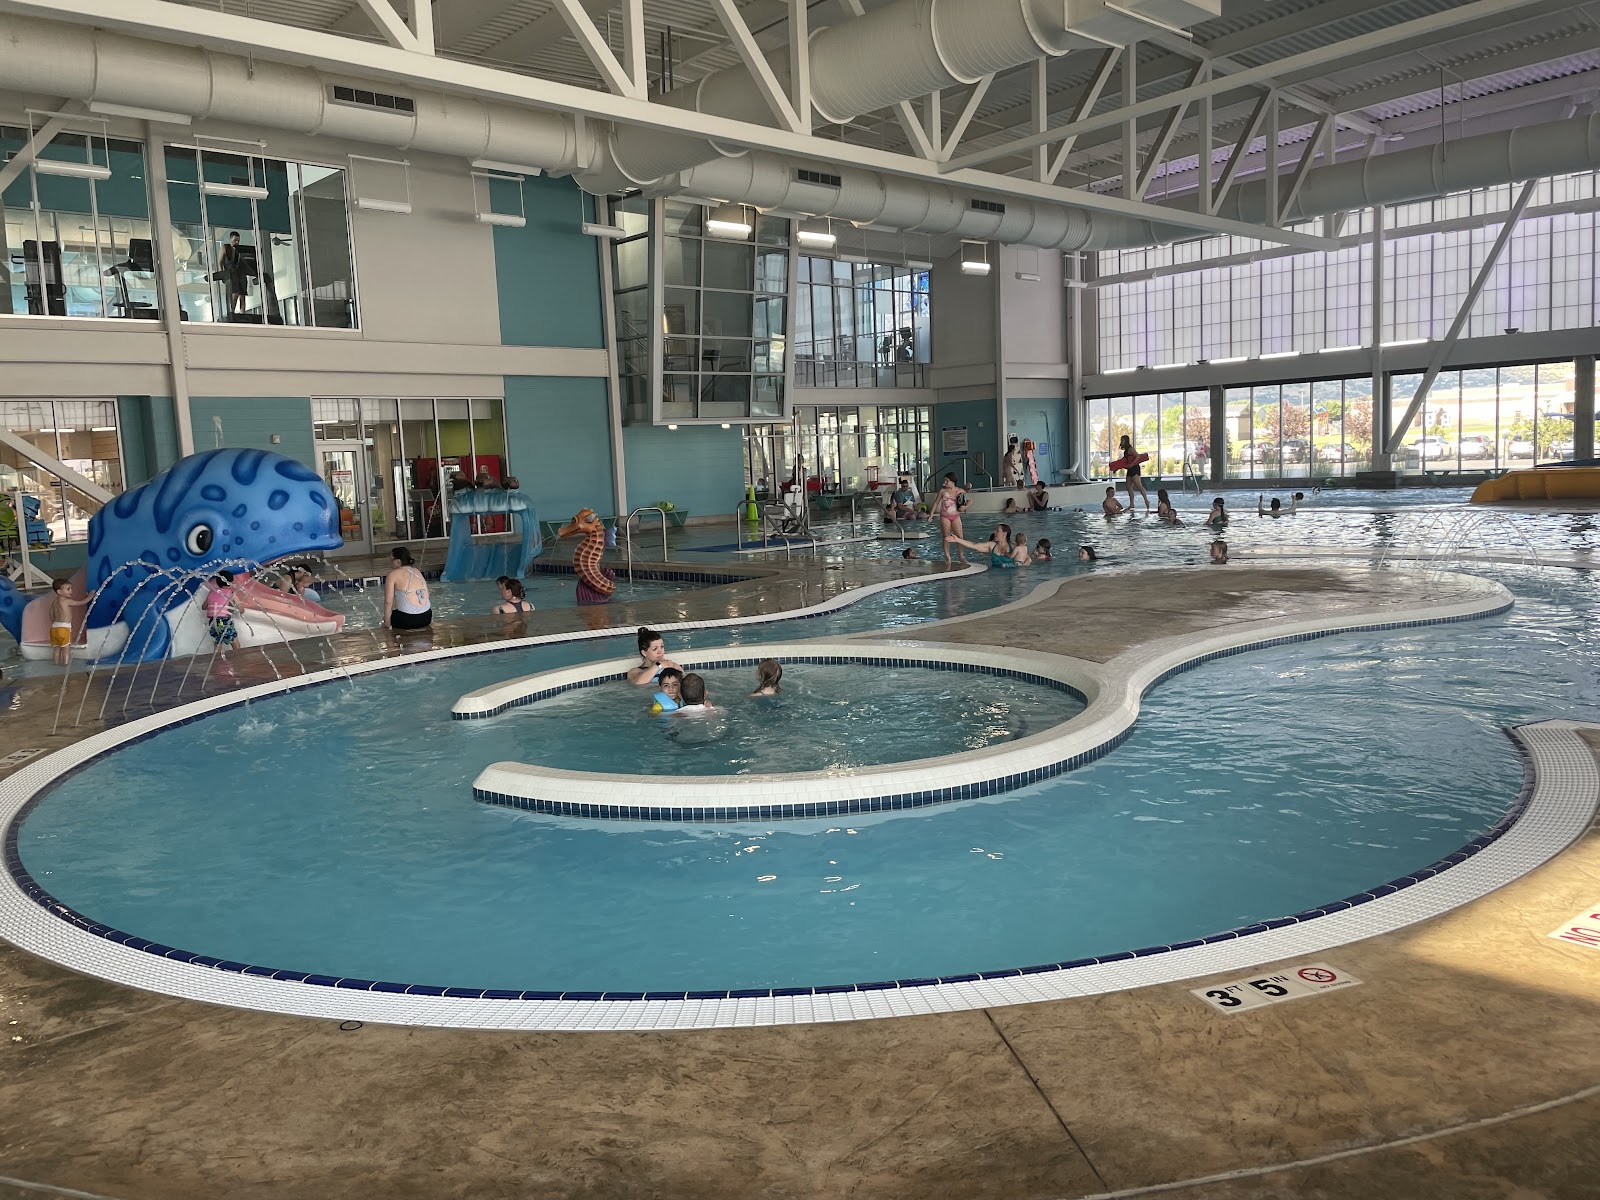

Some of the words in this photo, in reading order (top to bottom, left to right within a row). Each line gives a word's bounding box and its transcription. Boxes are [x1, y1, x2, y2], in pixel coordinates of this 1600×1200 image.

[1206, 990, 1242, 1007] 3
[1224, 985, 1243, 993] FT
[1248, 979, 1288, 996] 5
[1269, 975, 1289, 983] IN
